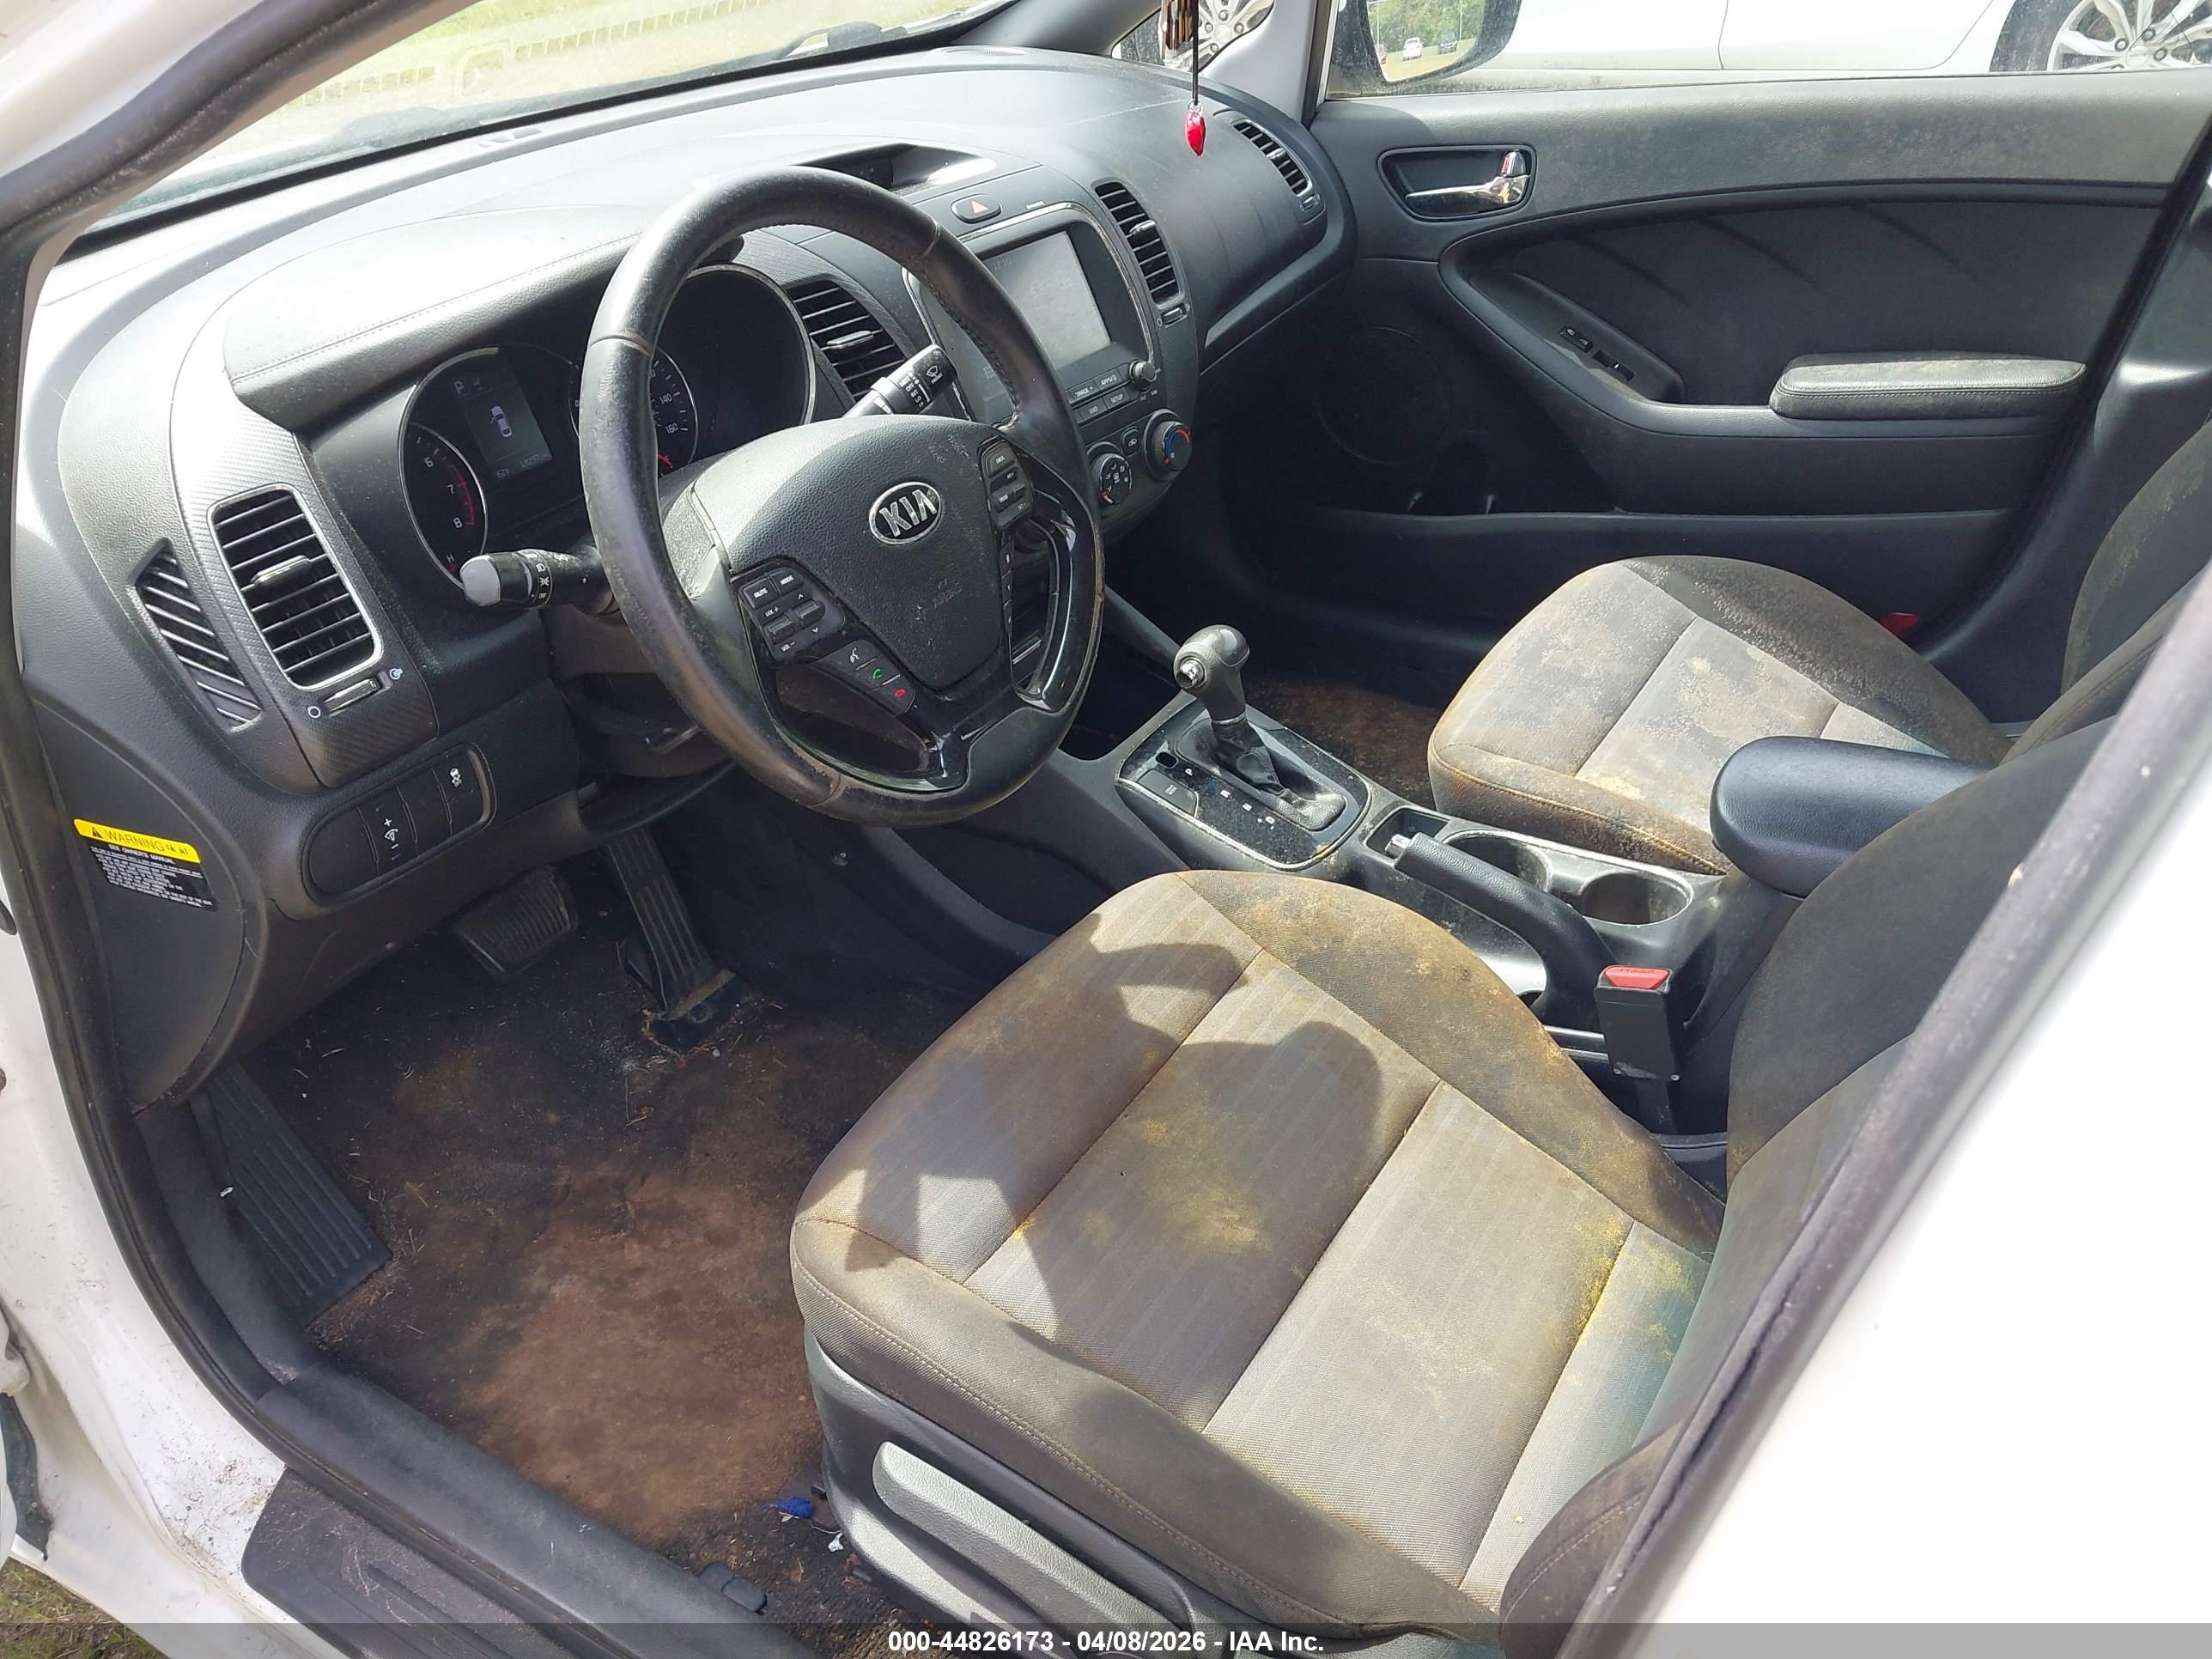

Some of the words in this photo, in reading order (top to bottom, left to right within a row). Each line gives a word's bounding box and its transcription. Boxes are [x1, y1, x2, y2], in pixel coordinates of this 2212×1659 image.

[659, 393, 672, 405] 140
[424, 456, 434, 468] 6
[447, 483, 454, 495] 7
[878, 489, 938, 538] KIA
[453, 517, 463, 529] 8
[446, 553, 455, 564] H
[780, 574, 794, 586] MODE
[753, 587, 769, 599] MUTE
[1184, 768, 1193, 776] P
[1265, 816, 1275, 824] D
[105, 830, 165, 852] WARNING
